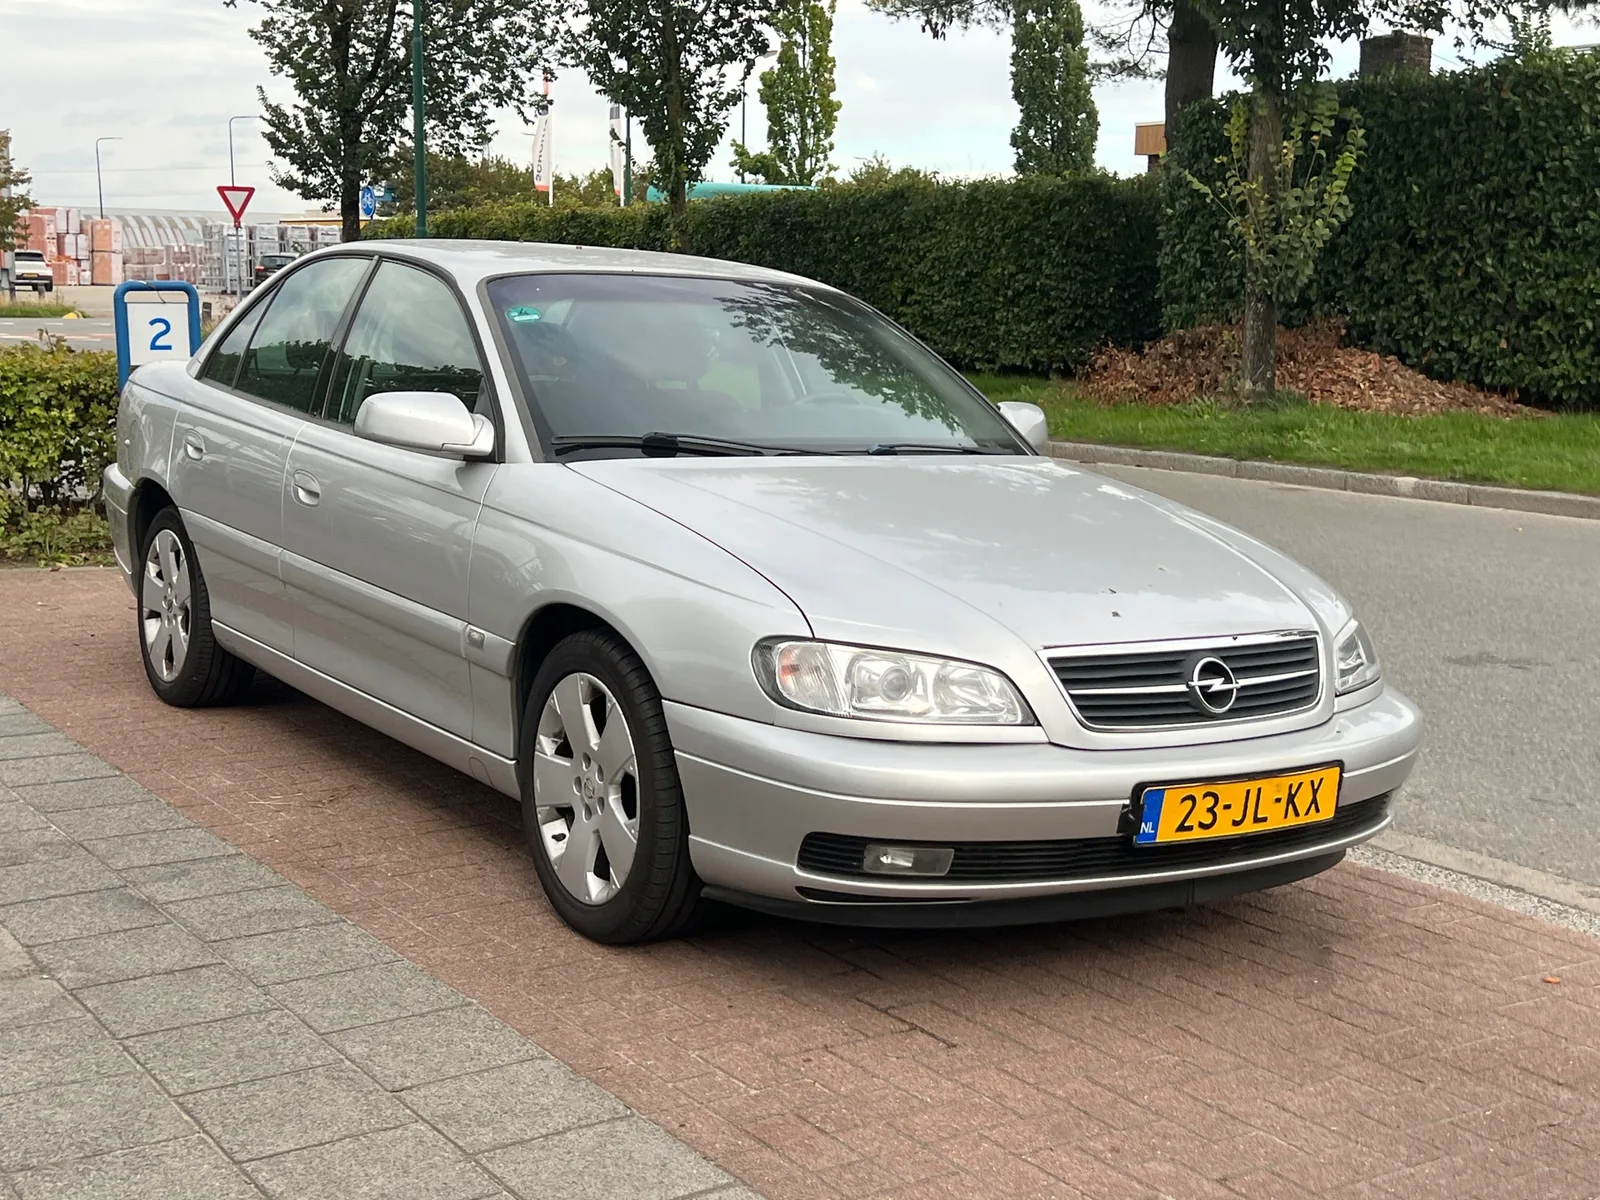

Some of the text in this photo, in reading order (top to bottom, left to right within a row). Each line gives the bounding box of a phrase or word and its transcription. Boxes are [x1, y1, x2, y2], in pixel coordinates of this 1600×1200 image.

[148, 317, 172, 350] 2
[1174, 777, 1325, 833] 23-JL-KX
[1140, 821, 1155, 834] NL
